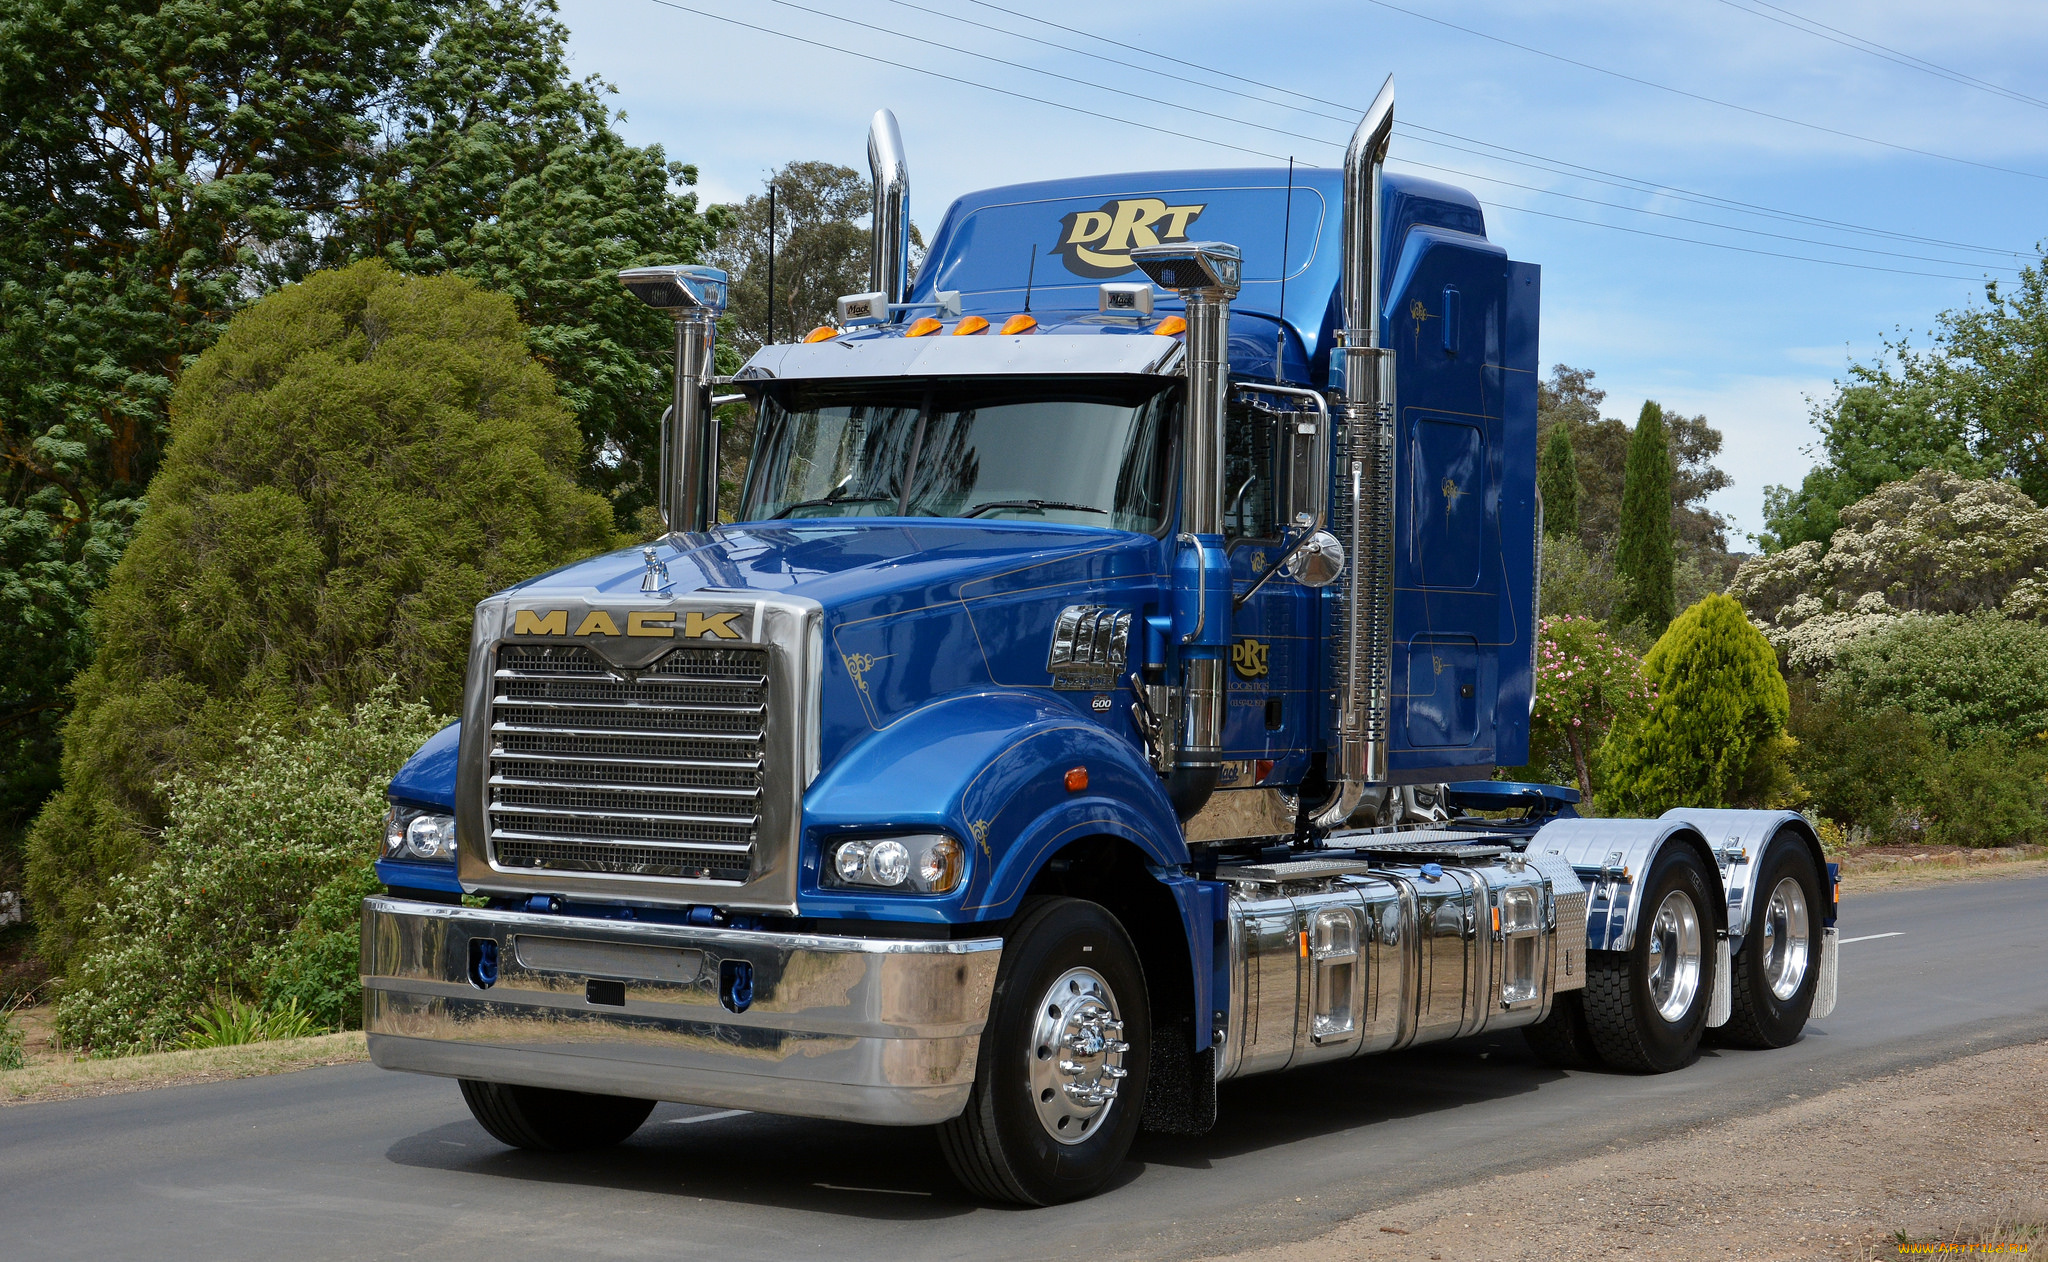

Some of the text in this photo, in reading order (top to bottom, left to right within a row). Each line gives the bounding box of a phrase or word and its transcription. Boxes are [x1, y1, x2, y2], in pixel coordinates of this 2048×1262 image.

[1066, 199, 1204, 268] DRT
[847, 304, 869, 315] Mack
[1109, 295, 1133, 306] Mack
[514, 610, 743, 639] MACK
[1232, 639, 1270, 677] DRT
[1091, 699, 1112, 708] 600
